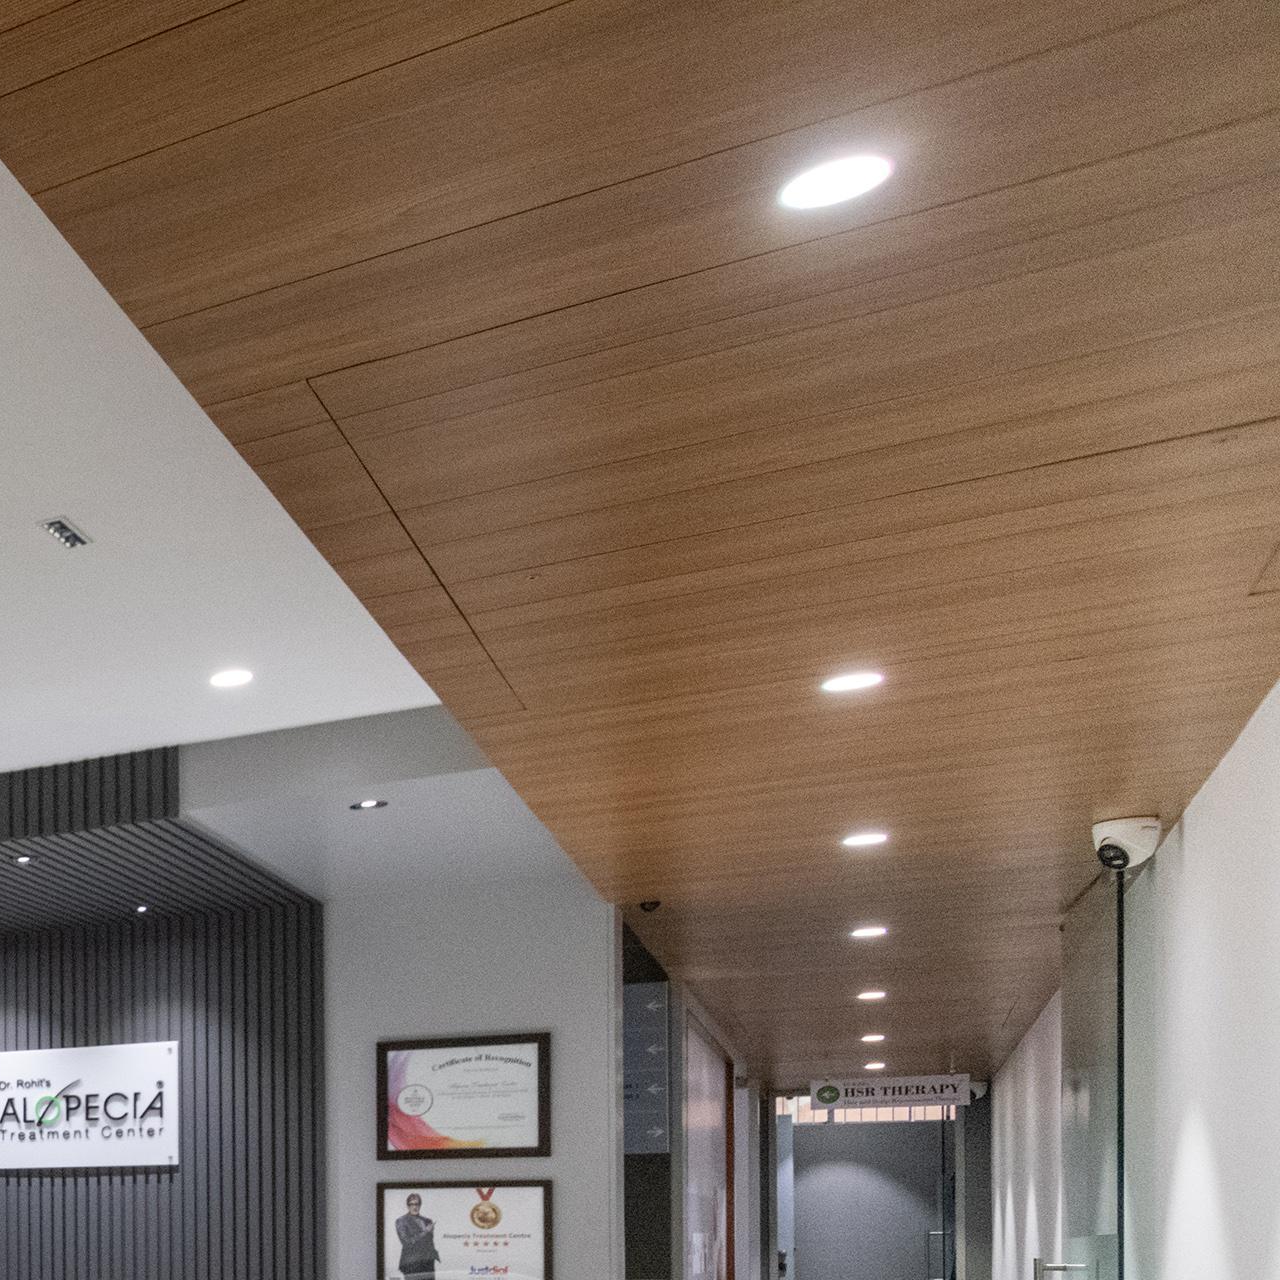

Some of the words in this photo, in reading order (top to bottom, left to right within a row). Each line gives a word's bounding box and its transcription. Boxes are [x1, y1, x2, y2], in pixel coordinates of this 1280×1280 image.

[431, 1055, 473, 1072] Certificate
[474, 1053, 483, 1062] of
[484, 1053, 532, 1068] Recognition
[16, 1078, 51, 1089] Rohit's
[844, 1087, 876, 1098] HSR
[879, 1084, 960, 1097] THERAPY
[0, 1091, 164, 1126] ALOPECIA
[0, 1128, 89, 1141] Treatment
[101, 1126, 165, 1139] Center
